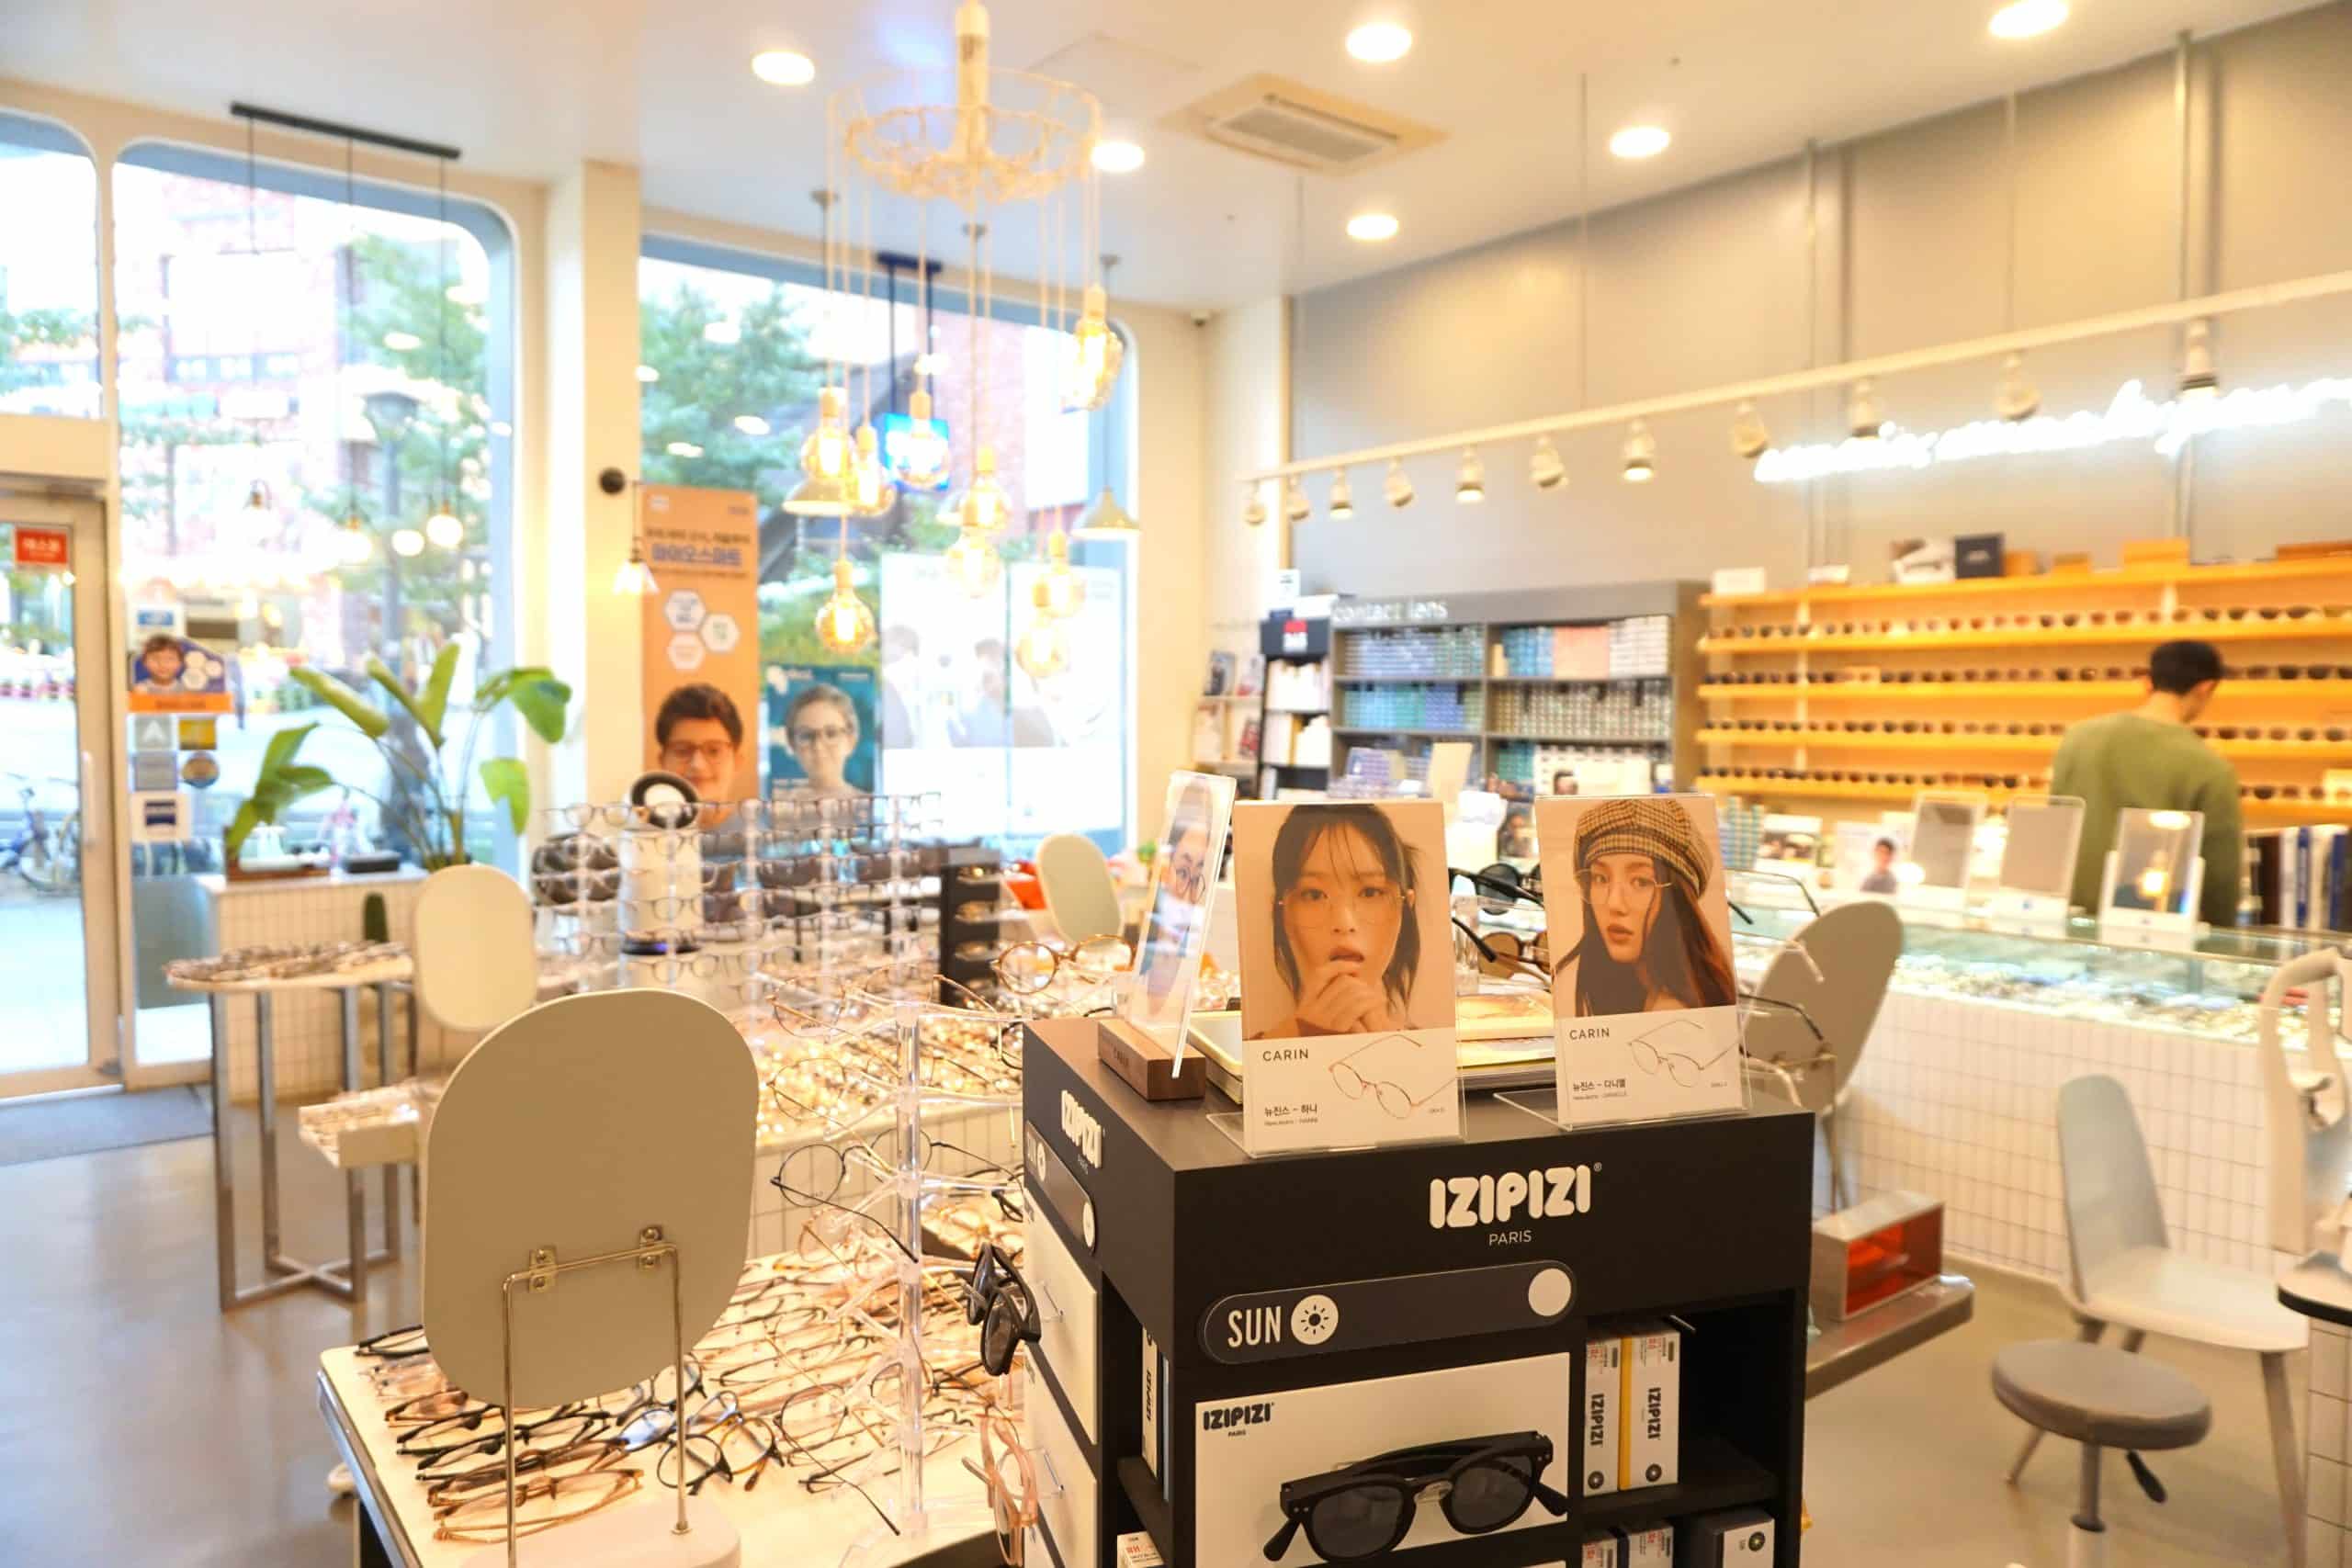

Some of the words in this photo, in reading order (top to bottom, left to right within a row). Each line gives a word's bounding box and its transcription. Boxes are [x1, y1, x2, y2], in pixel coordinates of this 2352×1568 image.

[1569, 1028, 1610, 1041] CARIN
[1262, 1048, 1309, 1062] CARIN
[1264, 1105, 1291, 1118] 뉴진스
[1429, 1164, 1591, 1229] IZIPIZI
[1488, 1229, 1532, 1246] PARIS
[1227, 1305, 1282, 1348] SUN
[1203, 1403, 1272, 1431] IZIPIZI
[1589, 1393, 1605, 1447] IZIPIZI
[1647, 1386, 1662, 1440] IZIPIZI
